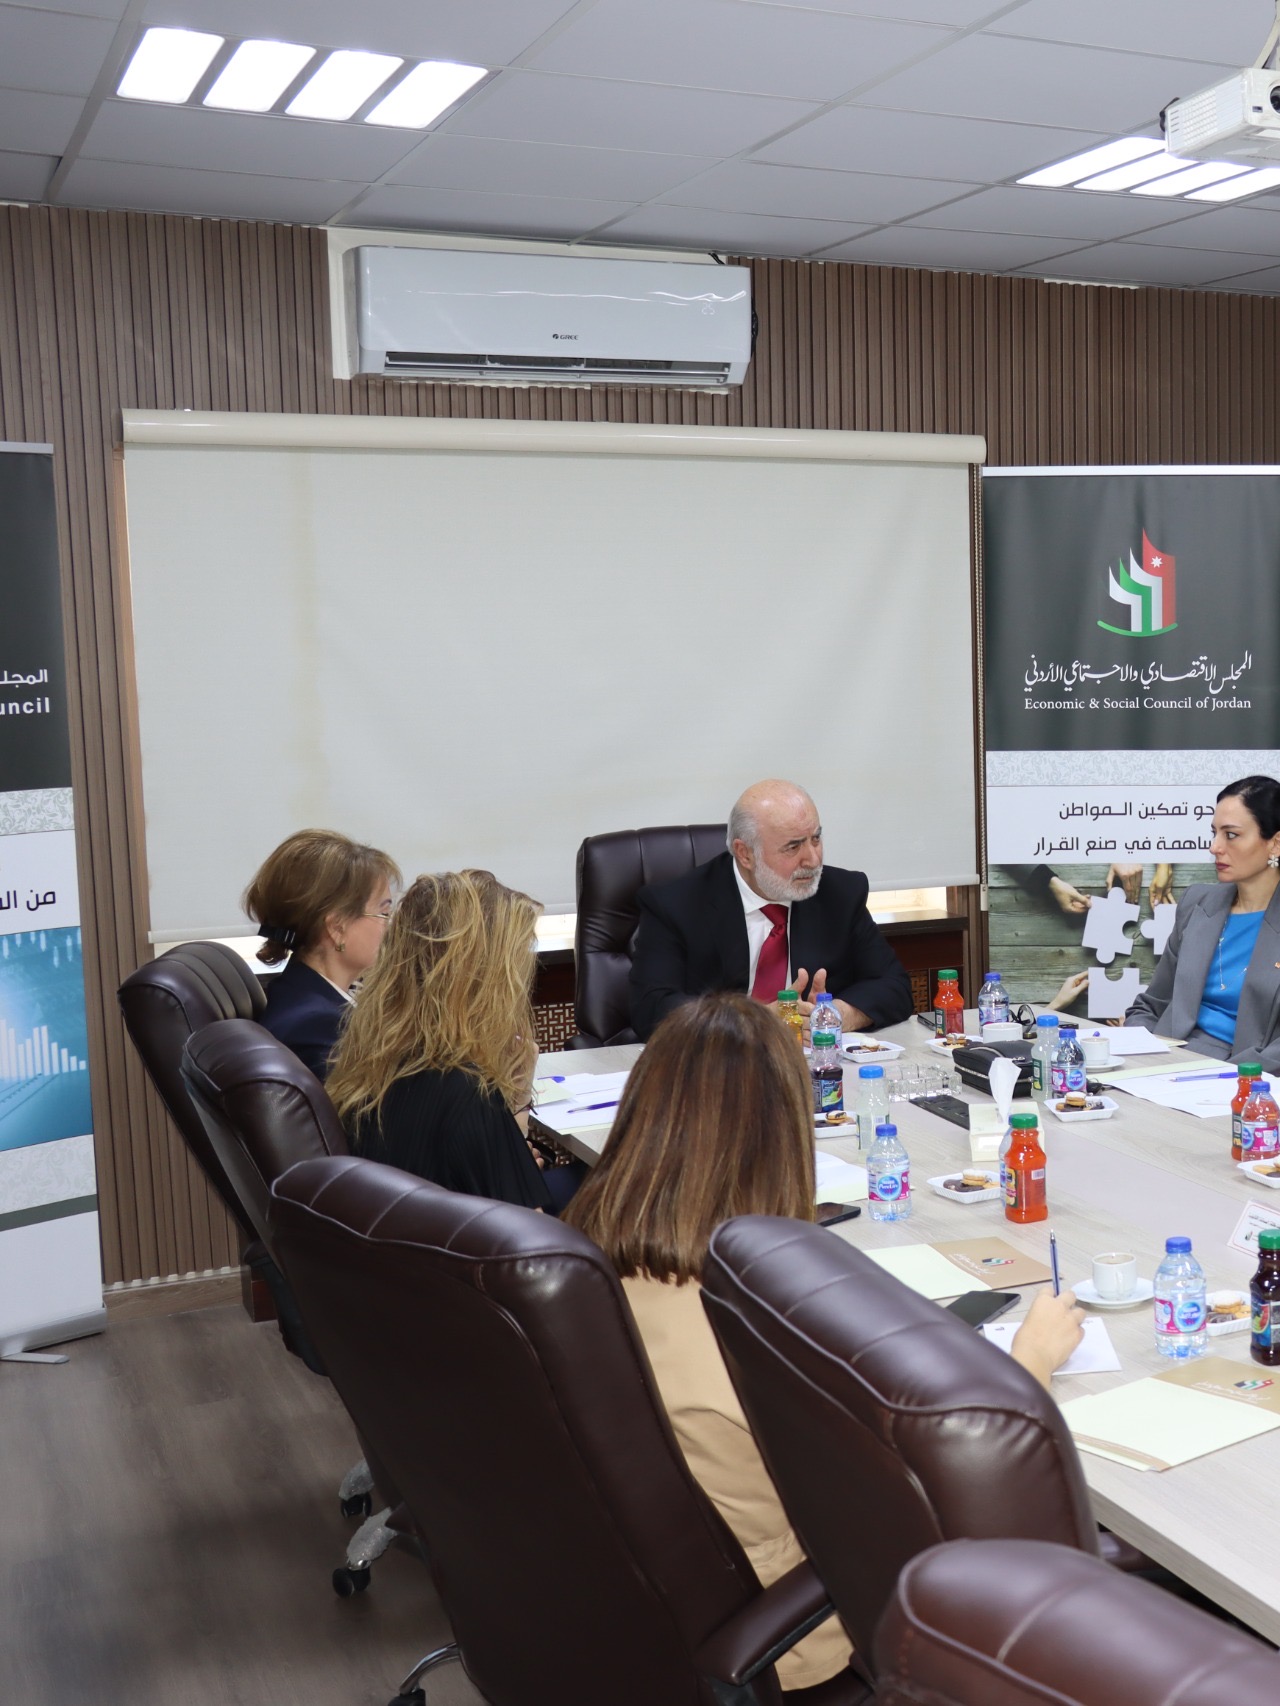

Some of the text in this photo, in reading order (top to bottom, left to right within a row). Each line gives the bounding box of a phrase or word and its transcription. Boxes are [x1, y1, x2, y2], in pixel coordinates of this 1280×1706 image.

[0, 668, 49, 689] المجل
[1023, 649, 1252, 695] المجلس الاقتصادي والاجتماعي الأردني
[1024, 696, 1252, 712] Economic & Social Council of Jordan
[1059, 801, 1215, 821] حو تمكين المواطن
[1033, 835, 1213, 856] ساهمة في صنع القرار
[26, 889, 57, 911] من
